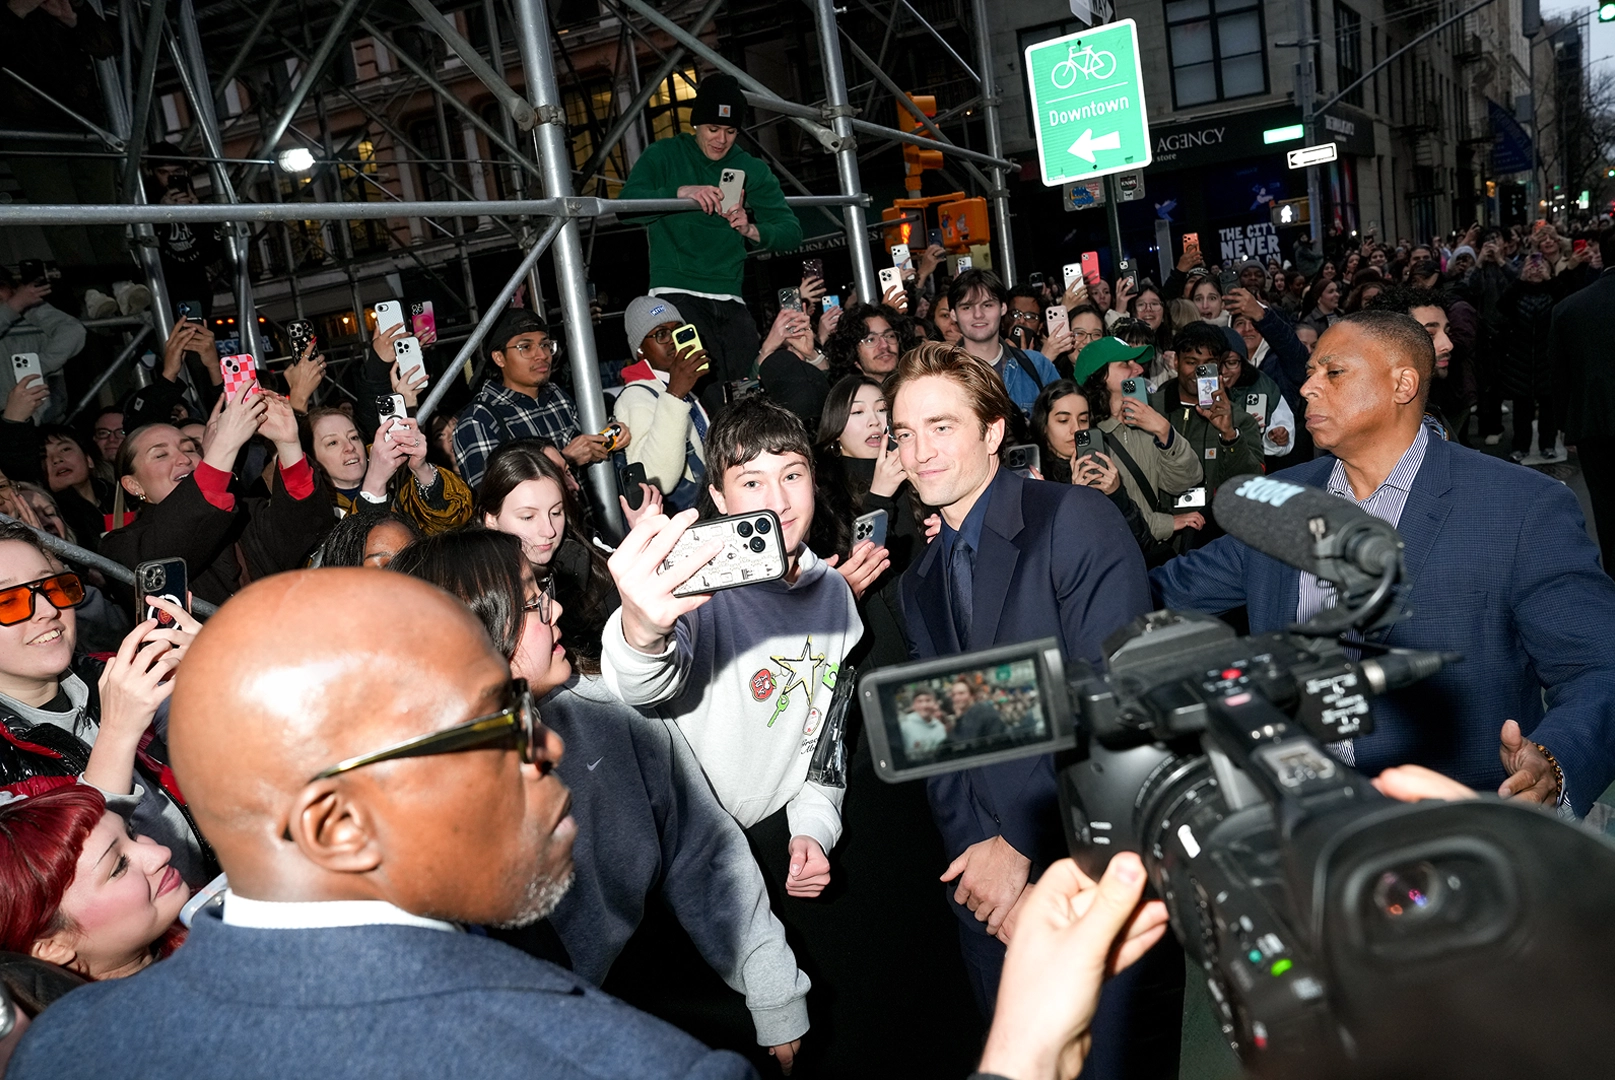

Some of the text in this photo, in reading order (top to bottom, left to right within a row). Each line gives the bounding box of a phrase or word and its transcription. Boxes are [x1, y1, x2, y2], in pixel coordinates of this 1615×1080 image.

[1048, 96, 1129, 127] Downtown
[1157, 127, 1225, 153] AGENCY
[1156, 153, 1177, 162] store
[1219, 222, 1276, 242] THE CITY
[1220, 235, 1280, 260] NEVER
